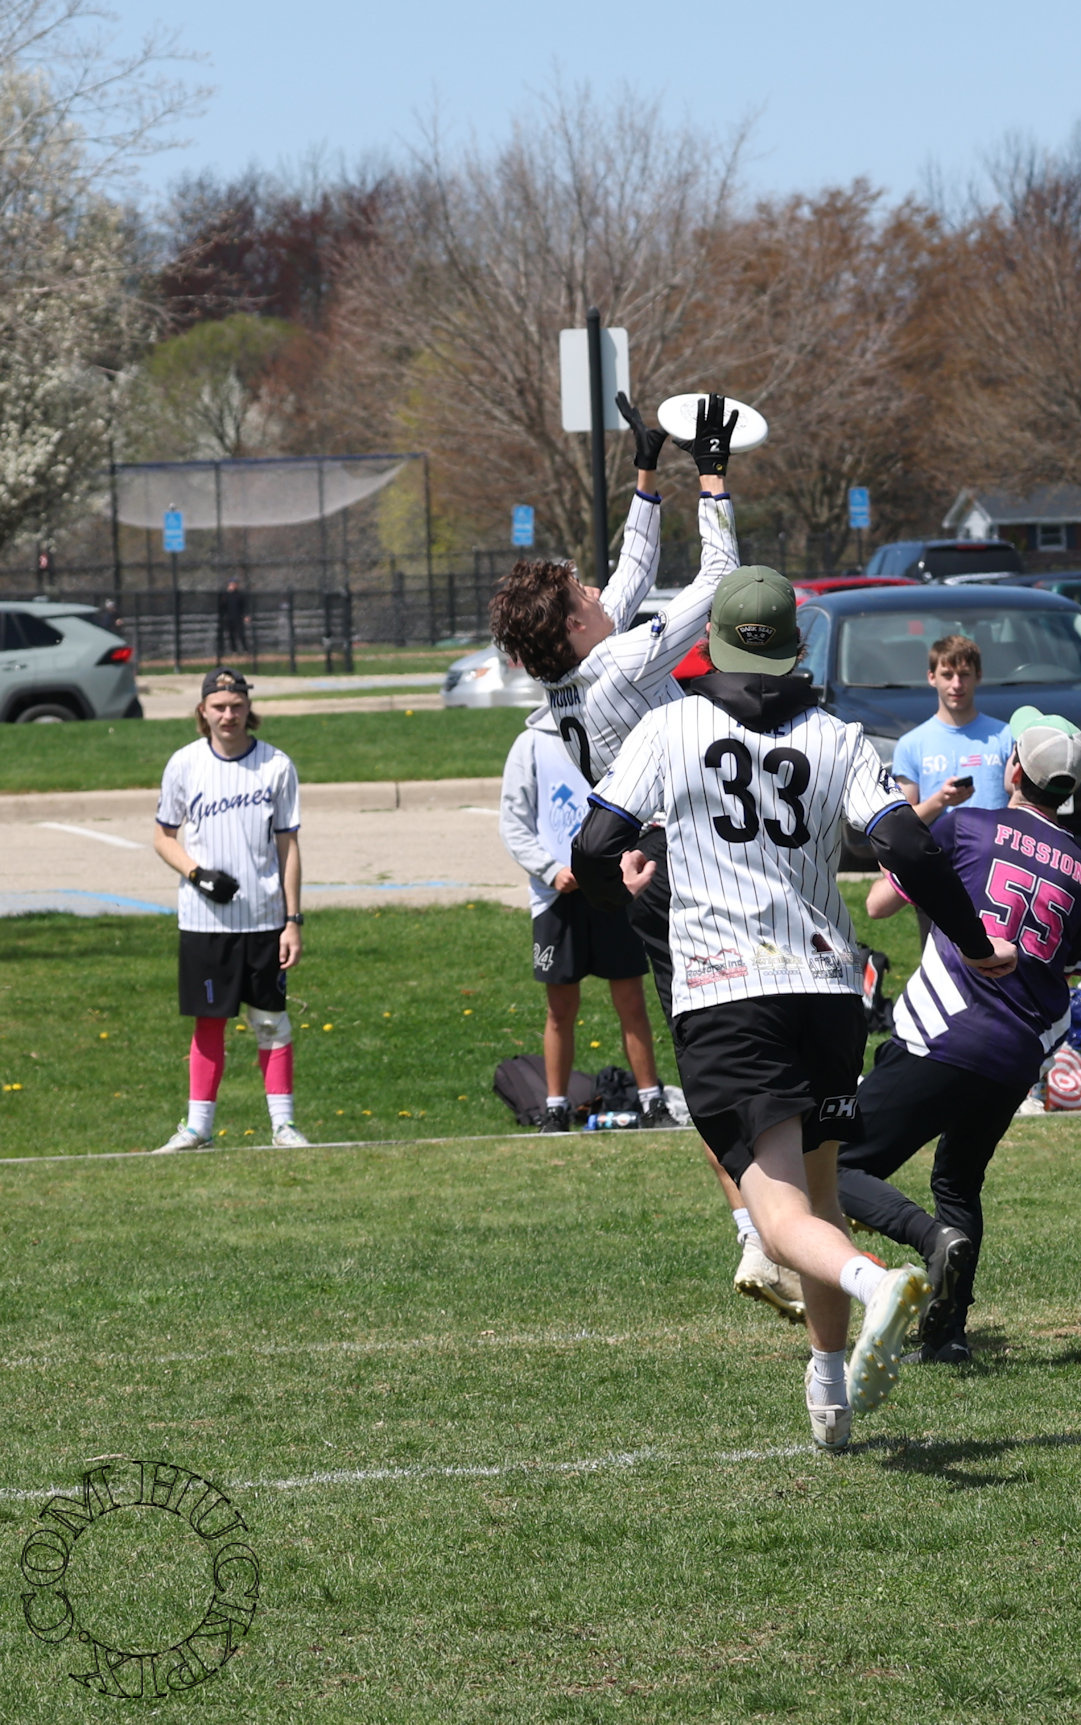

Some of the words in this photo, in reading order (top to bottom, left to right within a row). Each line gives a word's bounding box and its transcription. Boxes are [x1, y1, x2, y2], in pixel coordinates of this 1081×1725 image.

[709, 438, 721, 453] 2
[559, 716, 601, 788] 2
[189, 786, 274, 834] Gnomes
[704, 738, 811, 849] 33
[979, 858, 1076, 964] 55
[204, 978, 214, 1004] 1
